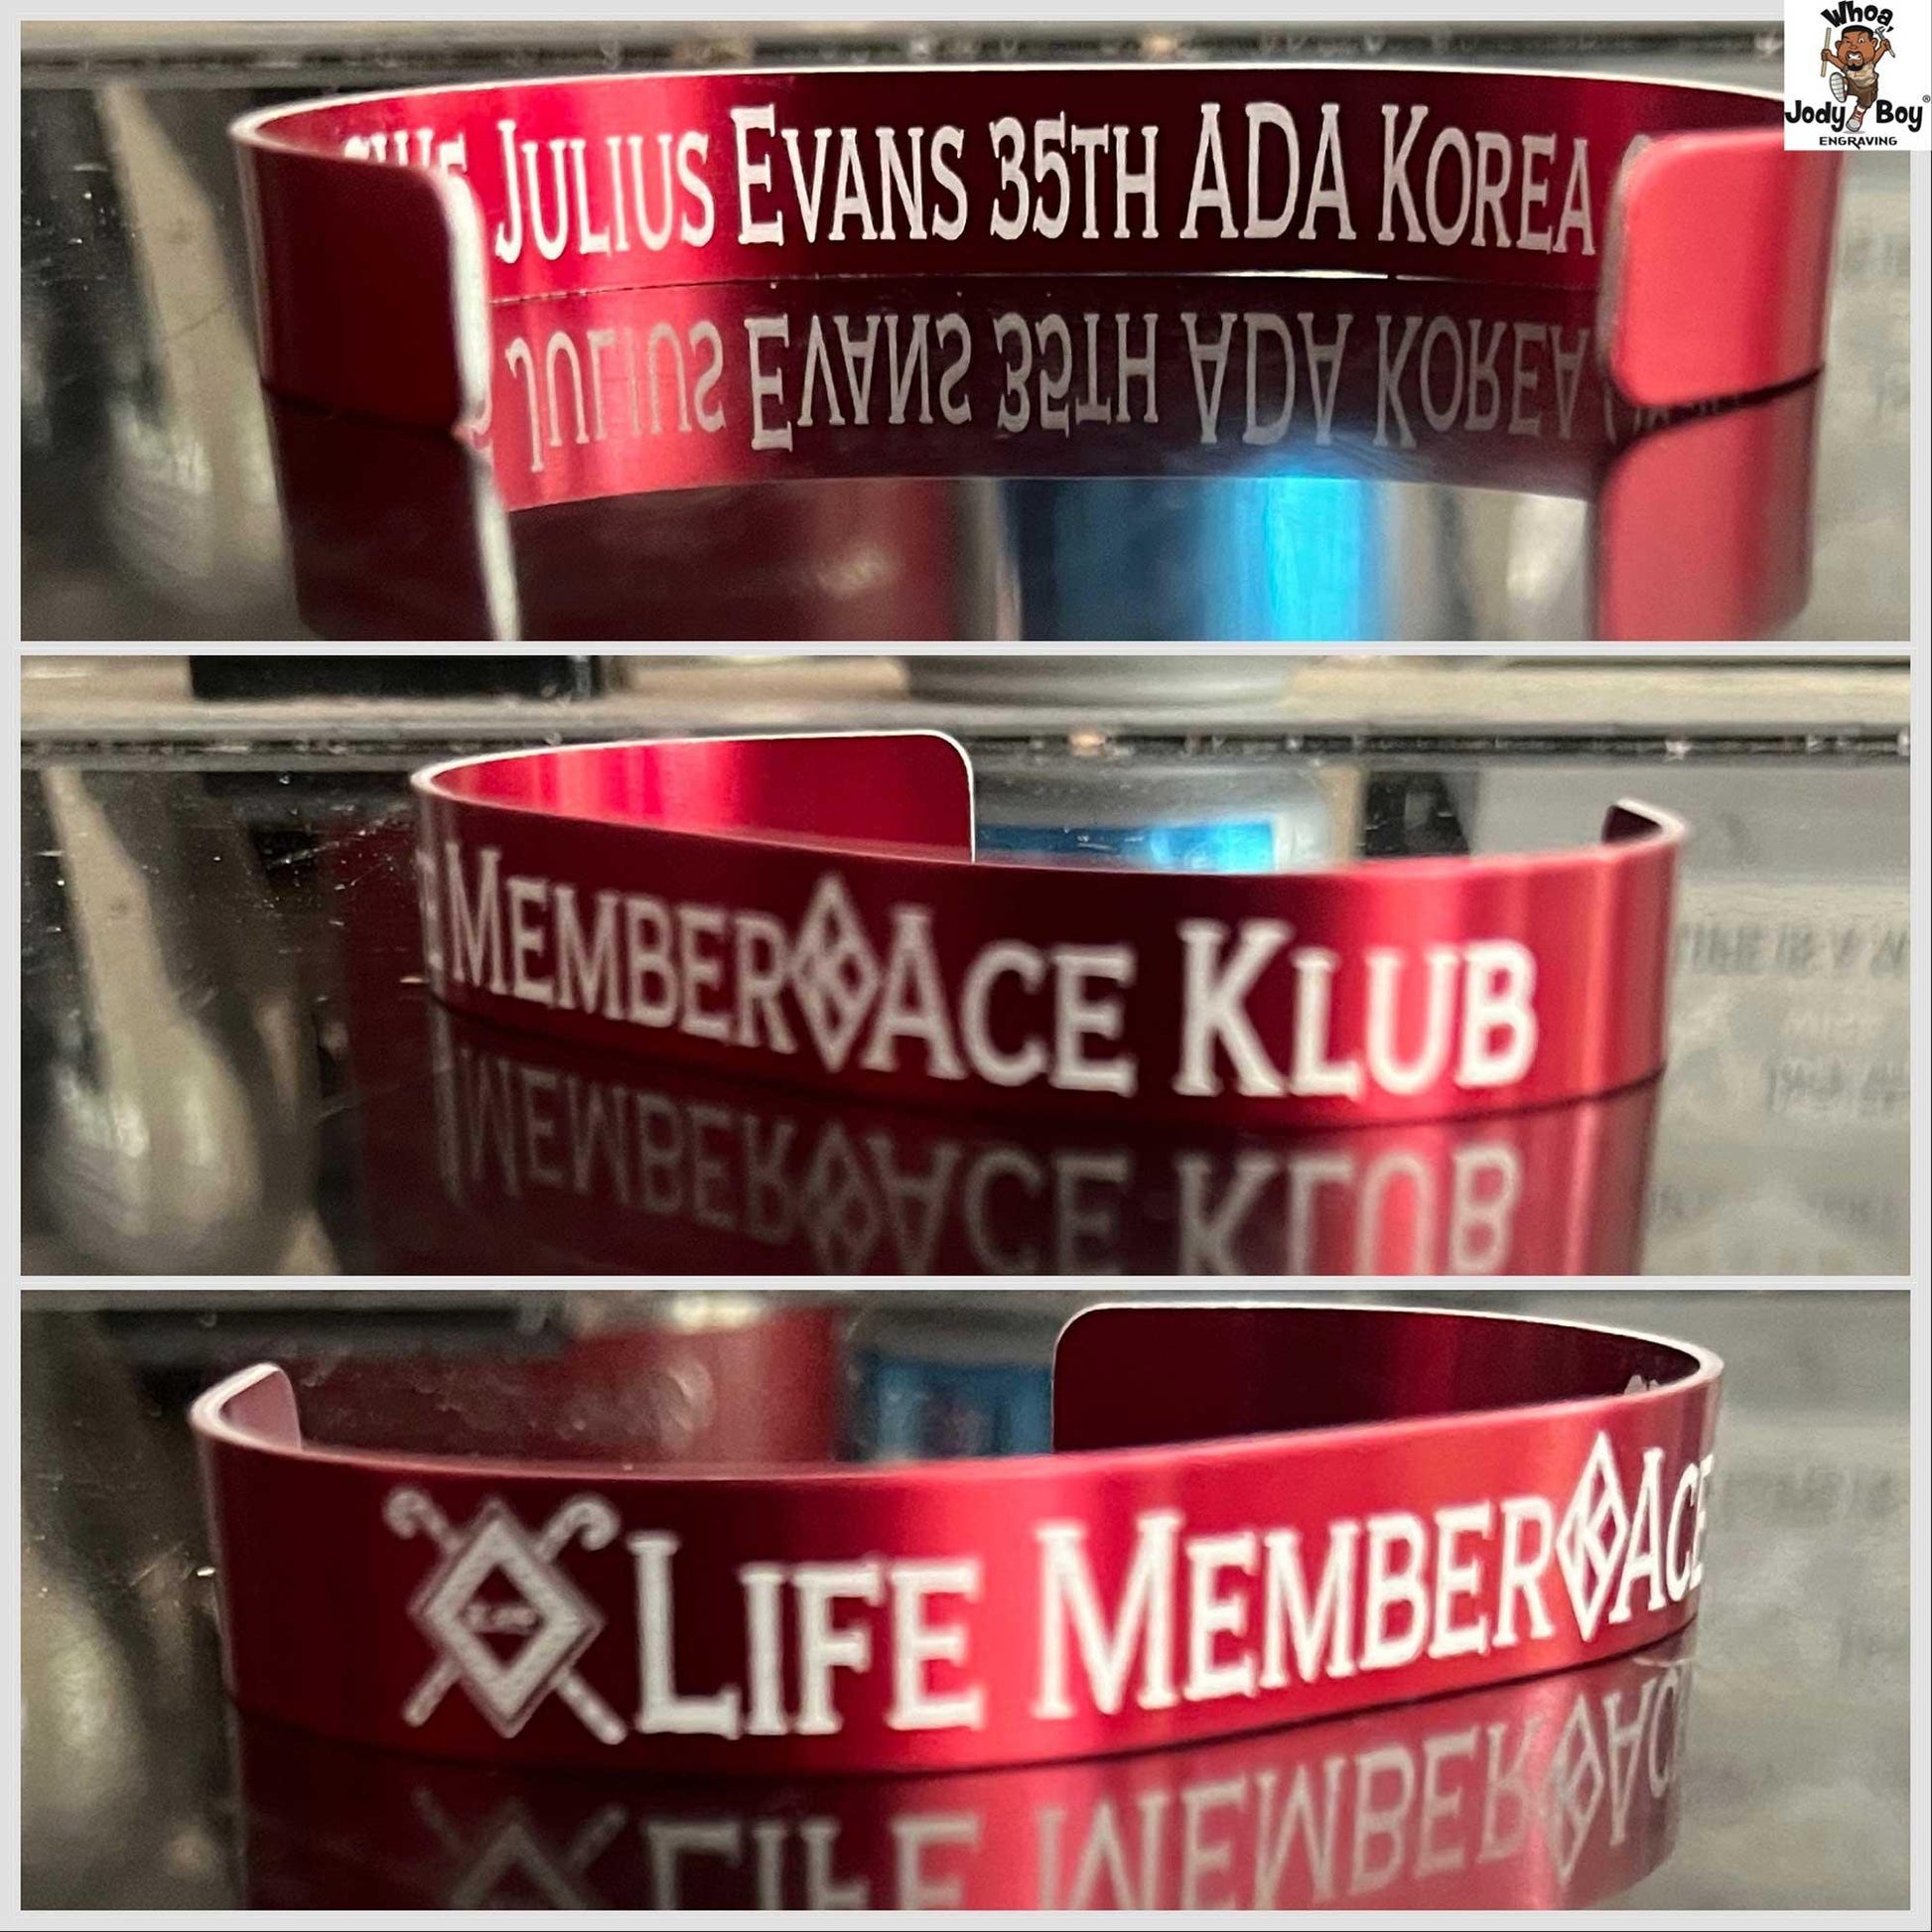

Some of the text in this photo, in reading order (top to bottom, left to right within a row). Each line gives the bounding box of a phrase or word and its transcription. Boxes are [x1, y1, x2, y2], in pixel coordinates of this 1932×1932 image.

[496, 103, 1596, 264] JULIUS EVANS 35TH ADA KOREA
[445, 840, 797, 1054] MEMBER
[860, 902, 1137, 1099] ACE
[1173, 917, 1538, 1101] KLUB
[627, 1531, 984, 1739] LIFE
[1031, 1496, 1555, 1720] MEMBER
